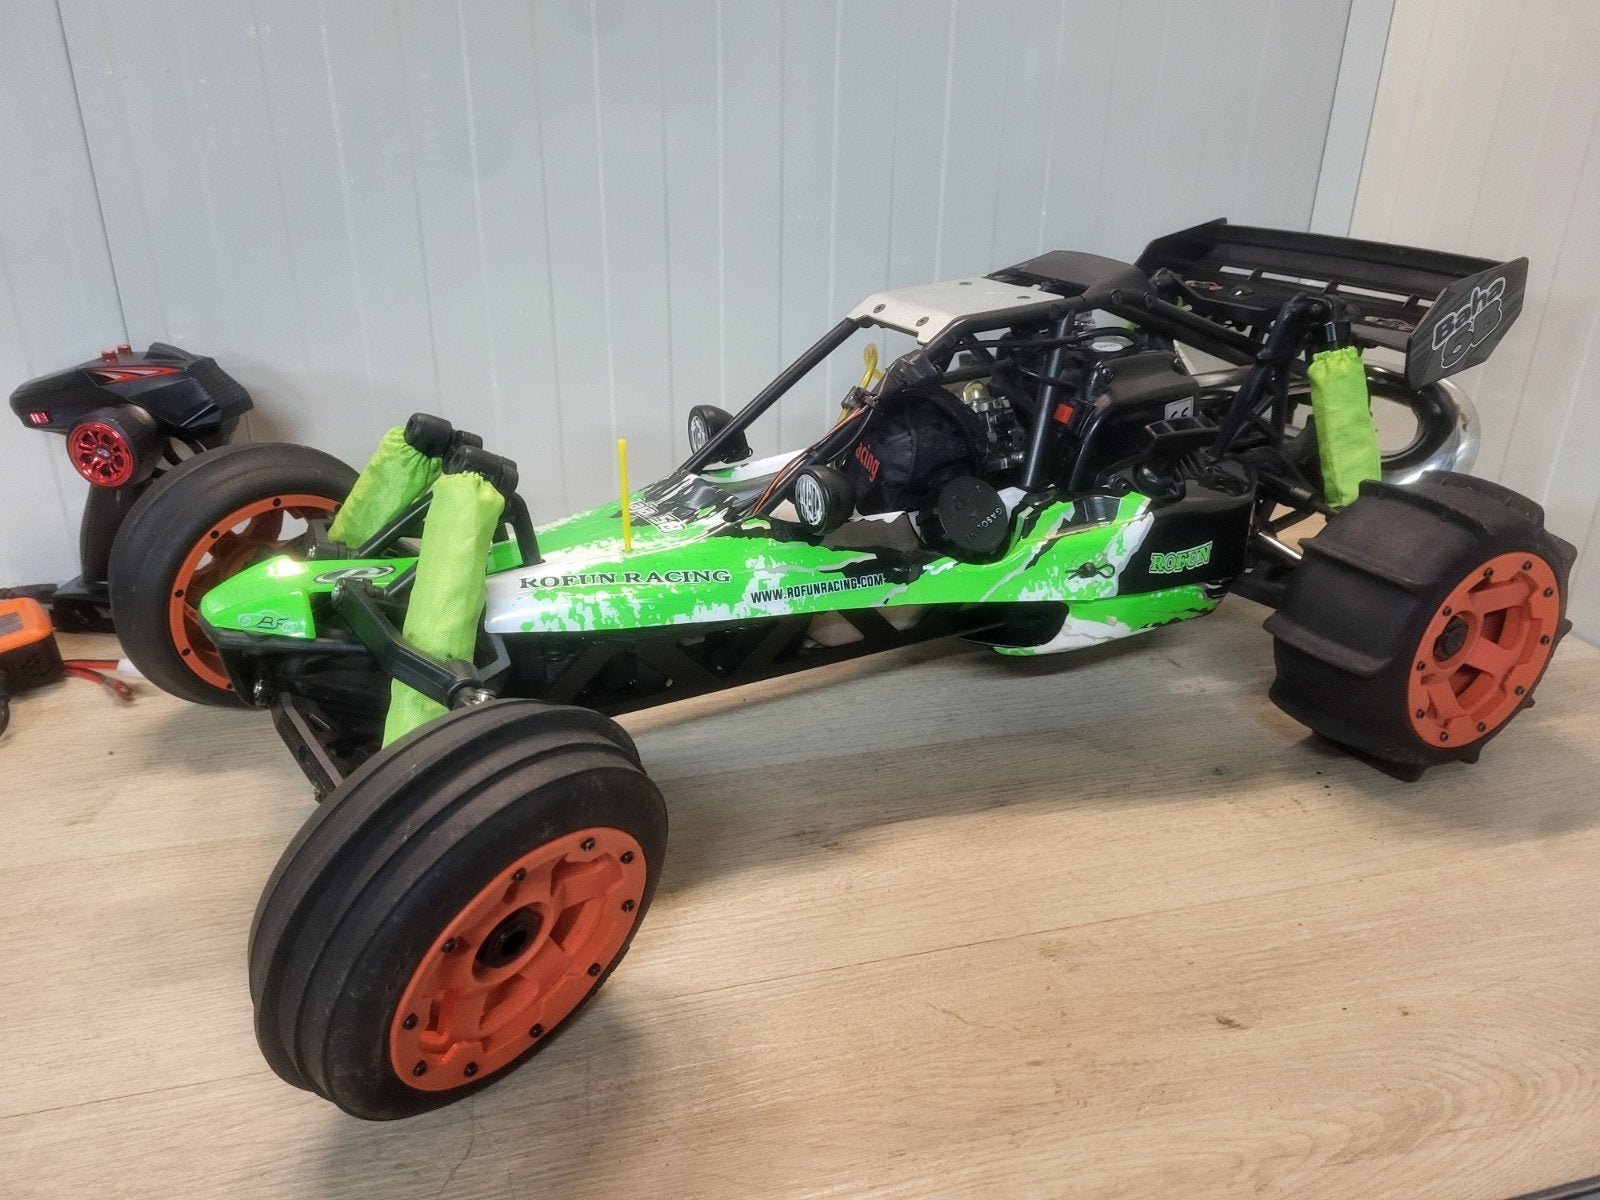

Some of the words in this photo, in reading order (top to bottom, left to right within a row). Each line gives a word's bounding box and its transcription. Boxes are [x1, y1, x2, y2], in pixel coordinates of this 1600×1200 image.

[1149, 541, 1213, 574] ROFUN
[519, 573, 616, 589] ROFUN
[623, 570, 731, 583] RACING
[750, 574, 884, 603] WWW.ROFUNRACING.COM
